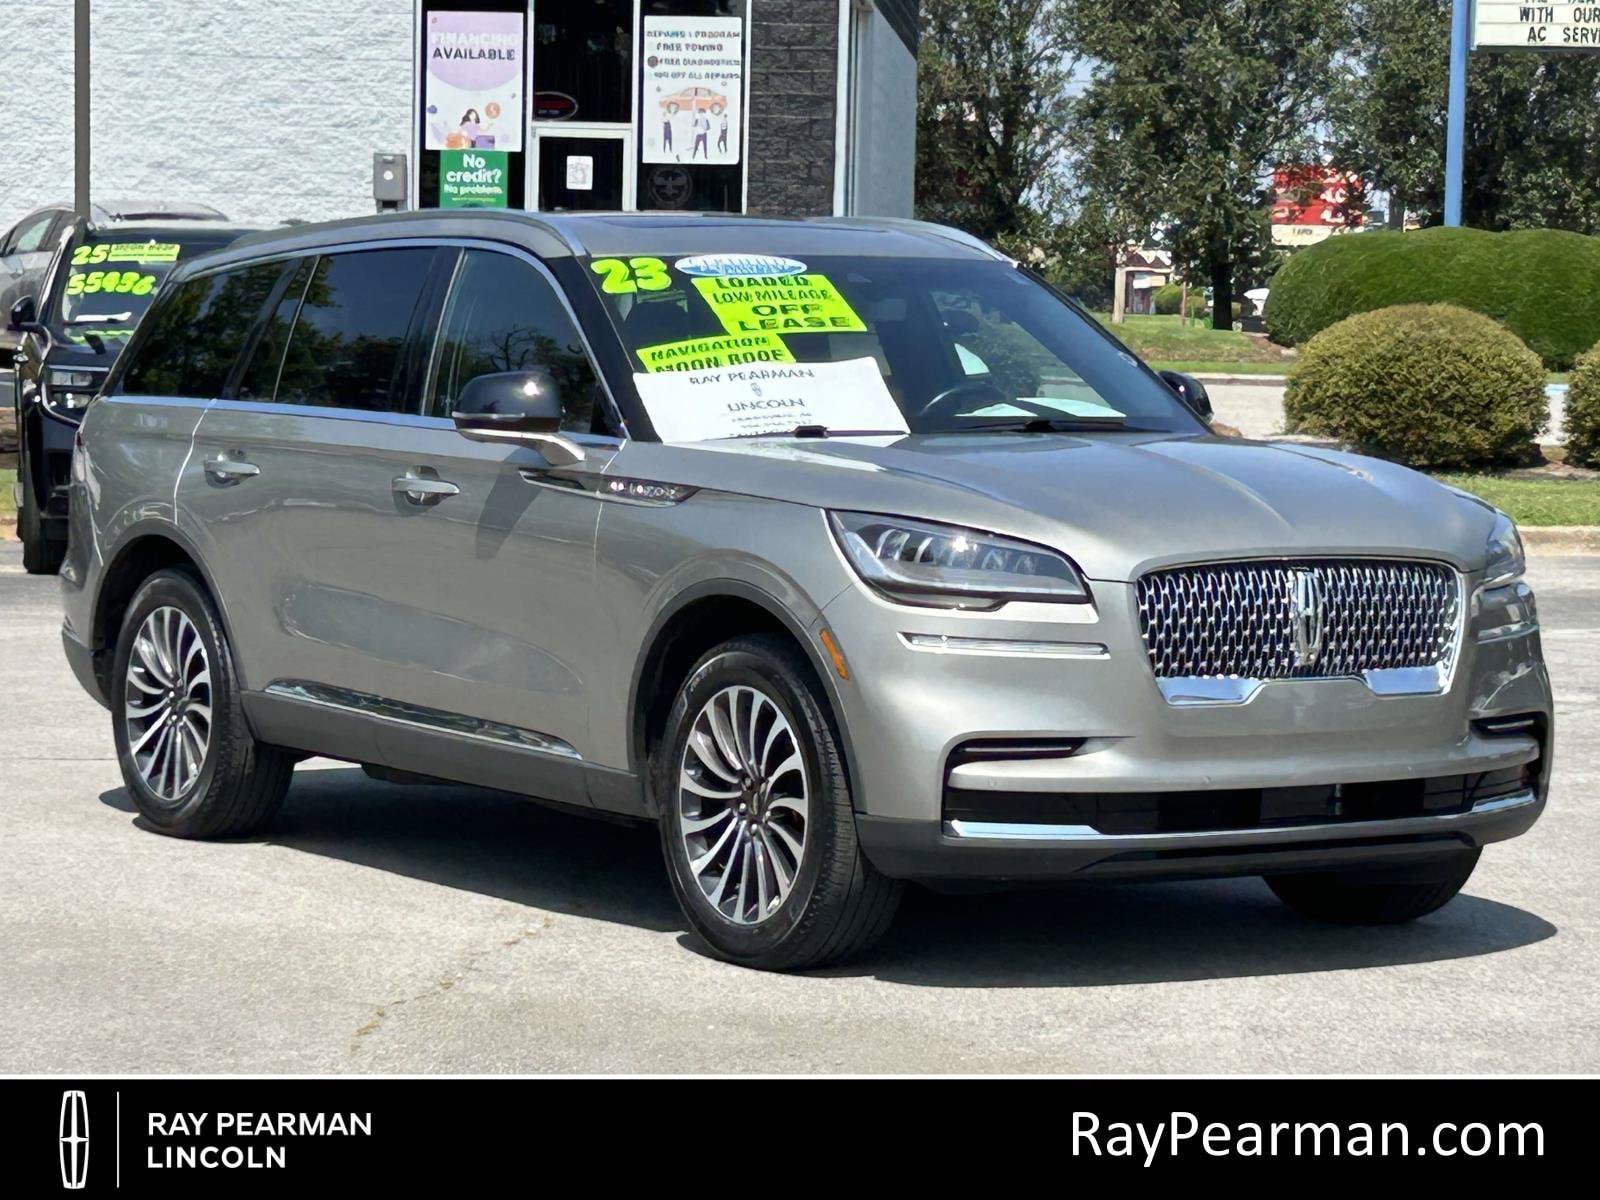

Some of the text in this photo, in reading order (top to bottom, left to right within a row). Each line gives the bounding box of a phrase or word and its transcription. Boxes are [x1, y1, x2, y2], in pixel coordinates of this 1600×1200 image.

[1519, 7, 1600, 23] WITH OUR
[1527, 26, 1547, 42] AC
[432, 47, 516, 60] AVAILABLE
[463, 153, 486, 168] No
[446, 168, 502, 183] credit?
[444, 184, 458, 194] No
[71, 244, 111, 265] 25
[591, 257, 672, 294] 23
[715, 275, 812, 289] LOADED
[712, 288, 833, 304] LOW MILEAGE
[751, 304, 823, 317] OFF
[738, 316, 850, 331] LEASE
[651, 336, 768, 361] NAVIGATION
[729, 349, 786, 366] ROOF
[690, 368, 816, 385] RAY PEARMAN
[727, 398, 807, 413] LINCOLN
